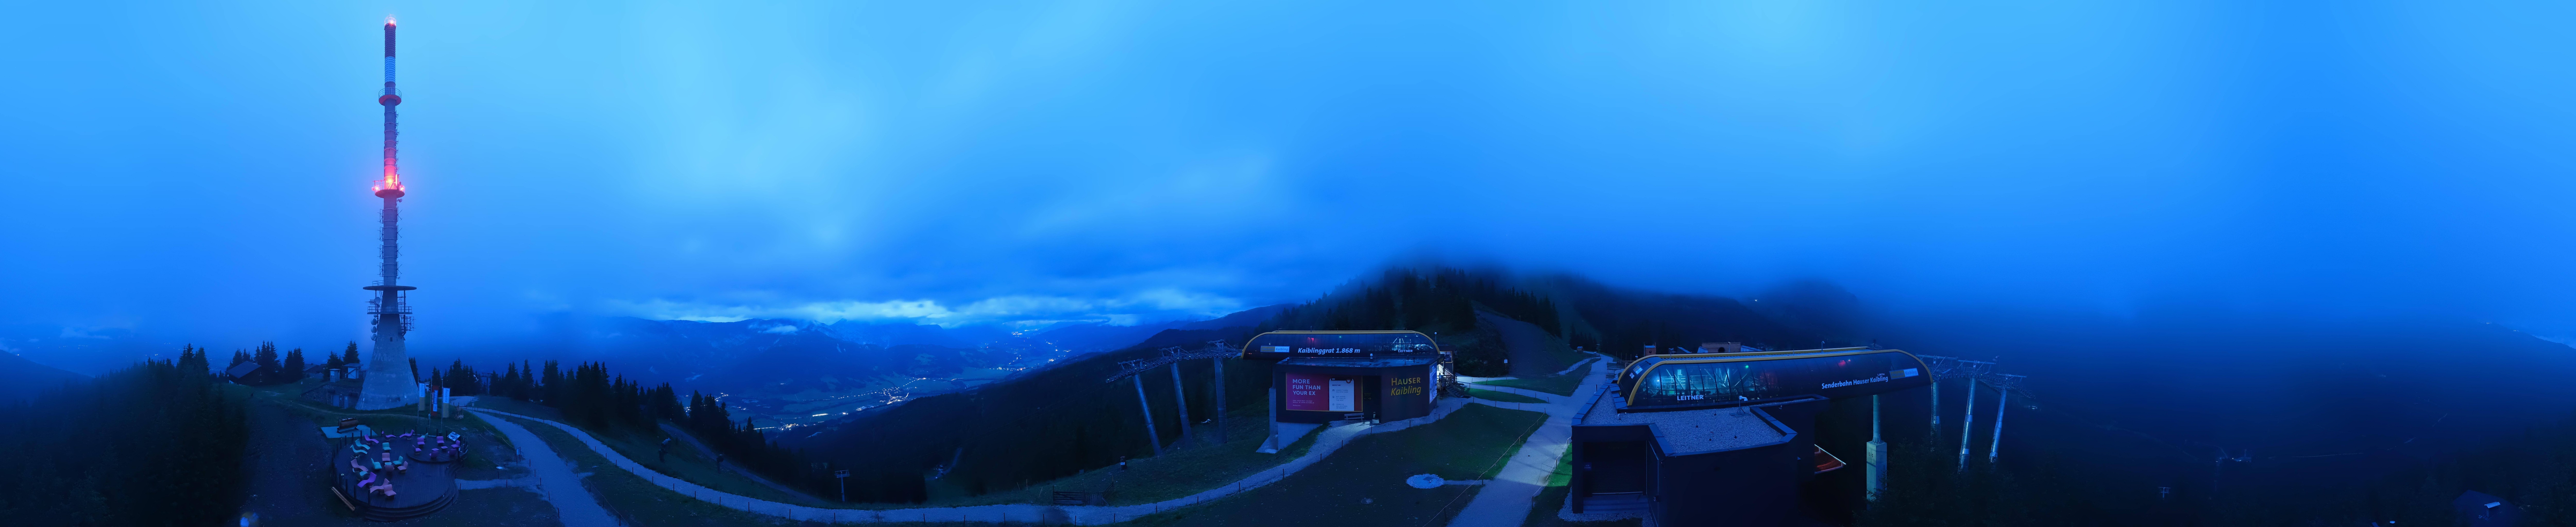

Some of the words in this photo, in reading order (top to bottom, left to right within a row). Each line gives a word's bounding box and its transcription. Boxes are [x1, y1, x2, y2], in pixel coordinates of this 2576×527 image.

[1391, 377, 1421, 386] HAUSER
[1822, 380, 1852, 389] Senderbahn
[1391, 386, 1421, 396] Kaibling
